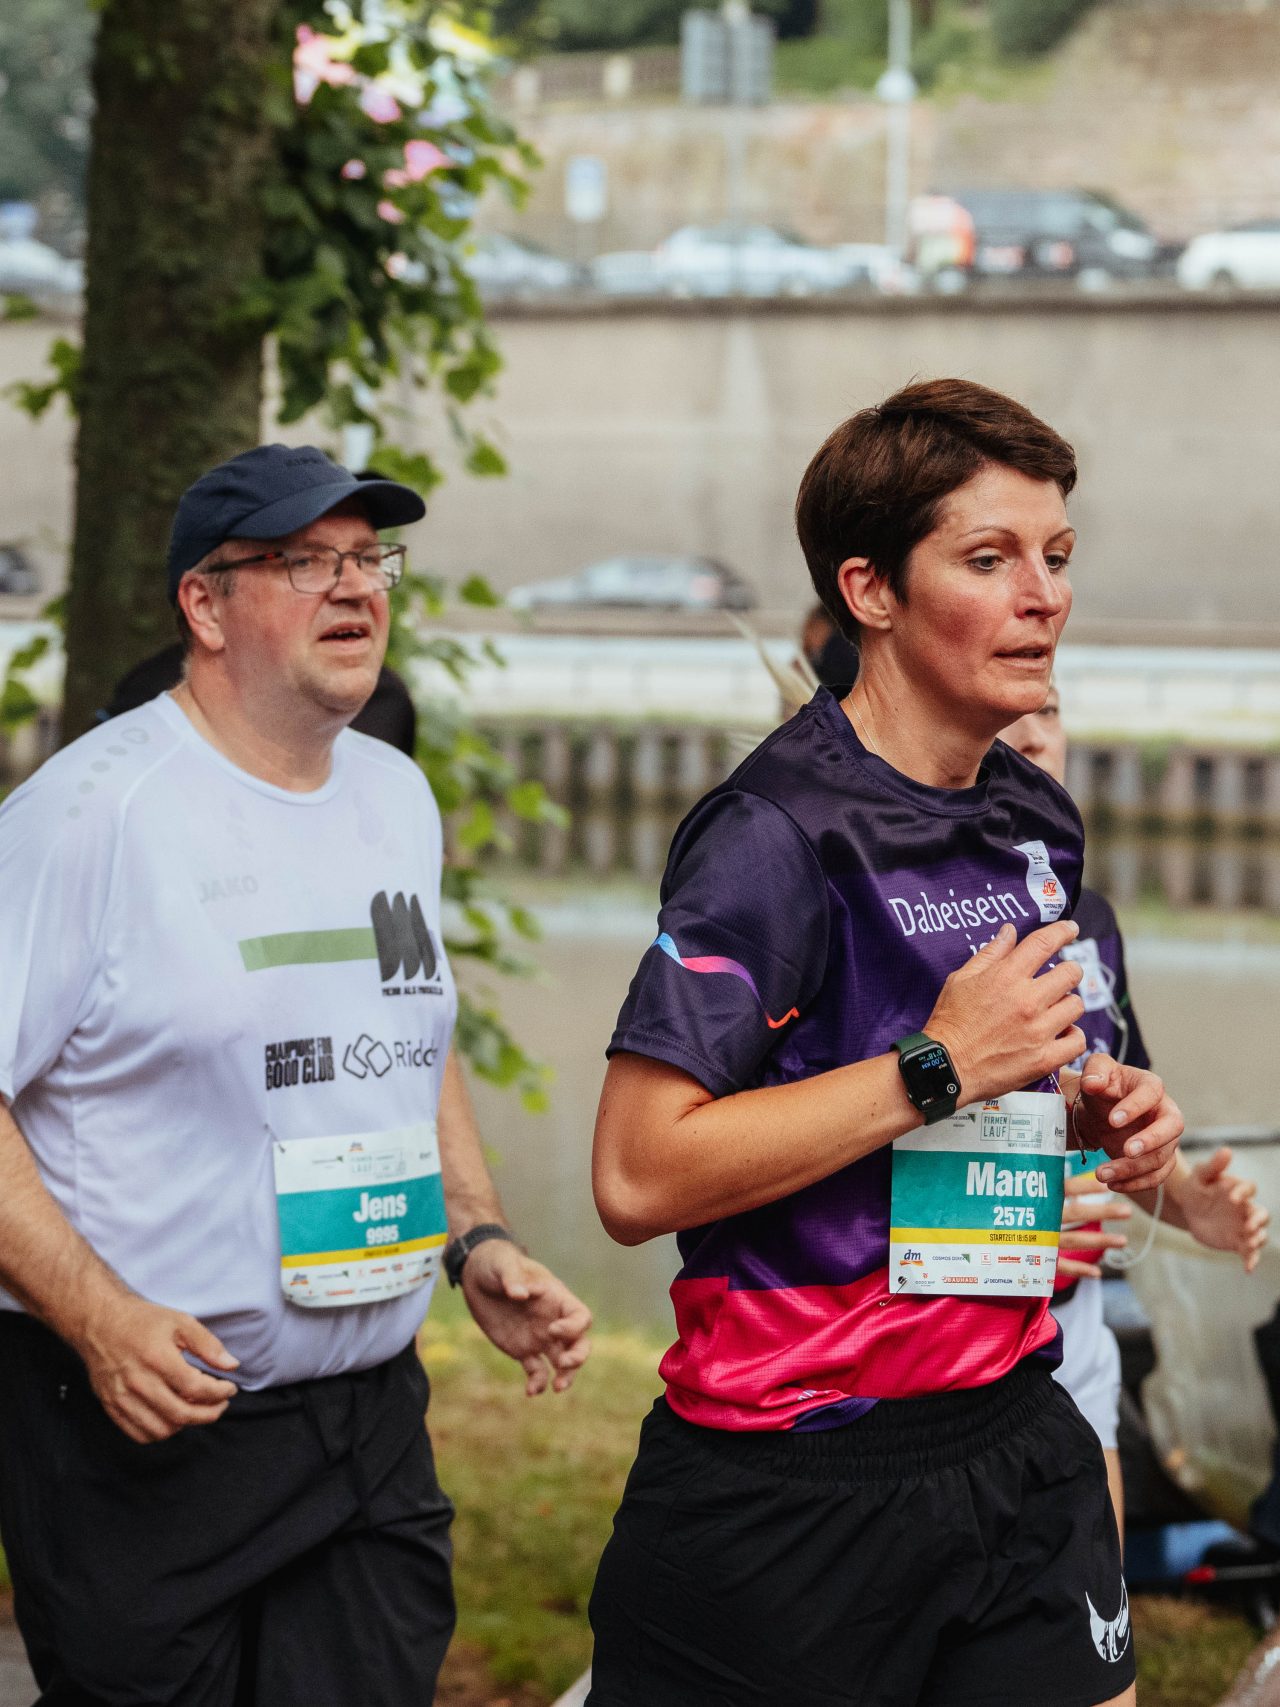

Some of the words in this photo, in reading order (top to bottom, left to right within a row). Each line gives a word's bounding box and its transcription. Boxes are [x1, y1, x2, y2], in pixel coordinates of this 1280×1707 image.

[888, 883, 1029, 936] Dabeisein
[266, 1060, 299, 1091] GOOD
[302, 1056, 335, 1084] CLUB
[984, 1115, 1008, 1125] FIRMEN
[983, 1126, 1007, 1138] LAUF
[966, 1161, 1048, 1198] Maren
[353, 1192, 408, 1223] Jens
[993, 1206, 1036, 1227] 2575
[990, 1233, 1015, 1242] STARTZEIT
[903, 1249, 921, 1260] dm
